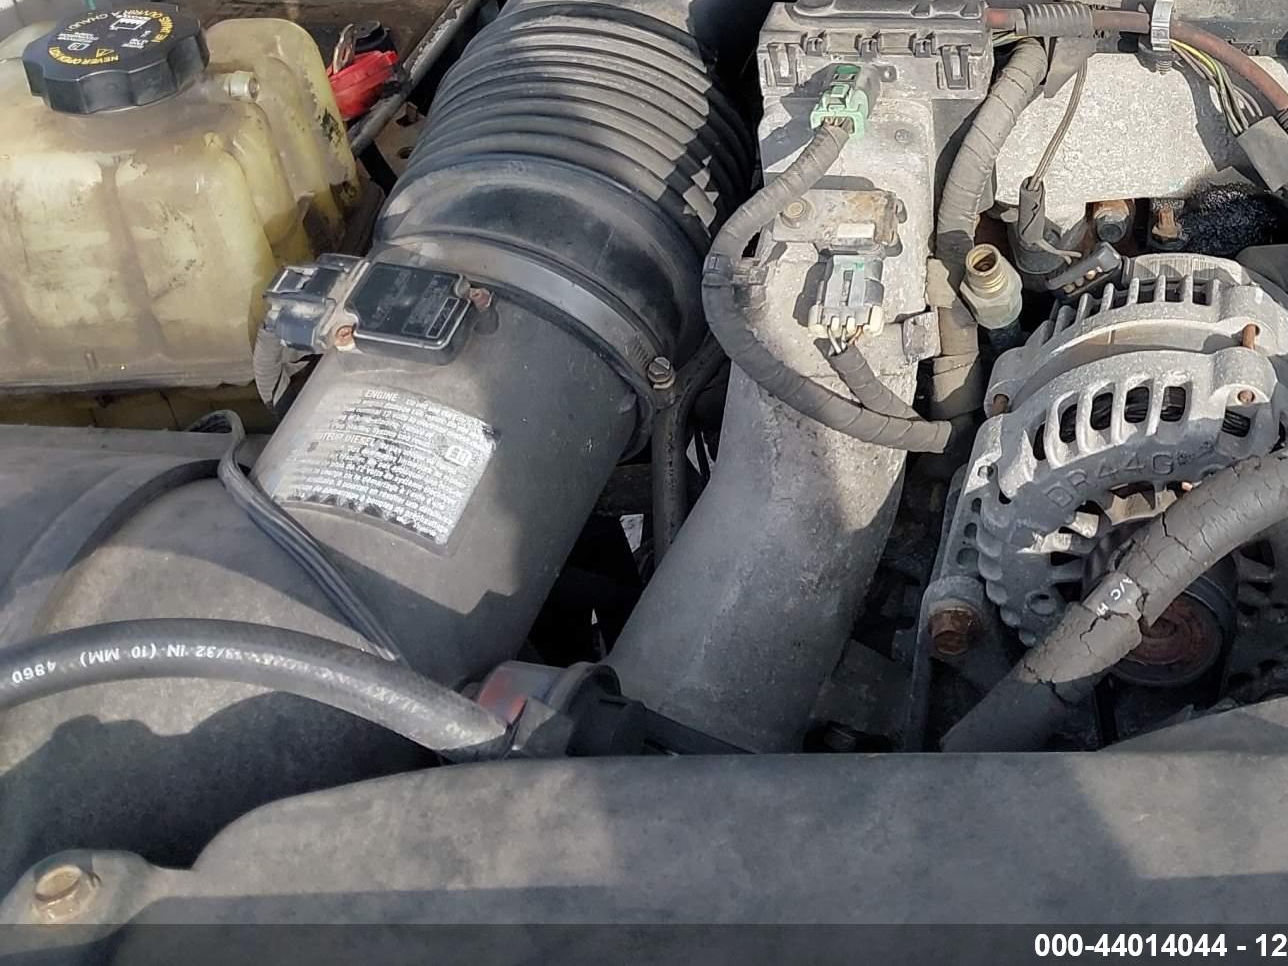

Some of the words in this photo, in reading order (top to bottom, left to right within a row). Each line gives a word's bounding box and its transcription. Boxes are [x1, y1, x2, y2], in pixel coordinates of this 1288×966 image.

[82, 54, 119, 65] NEVER
[364, 389, 399, 402] ENGINE
[79, 646, 120, 668] MM)
[131, 643, 158, 660] (10
[166, 643, 186, 657] IN
[11, 659, 57, 684] 4860
